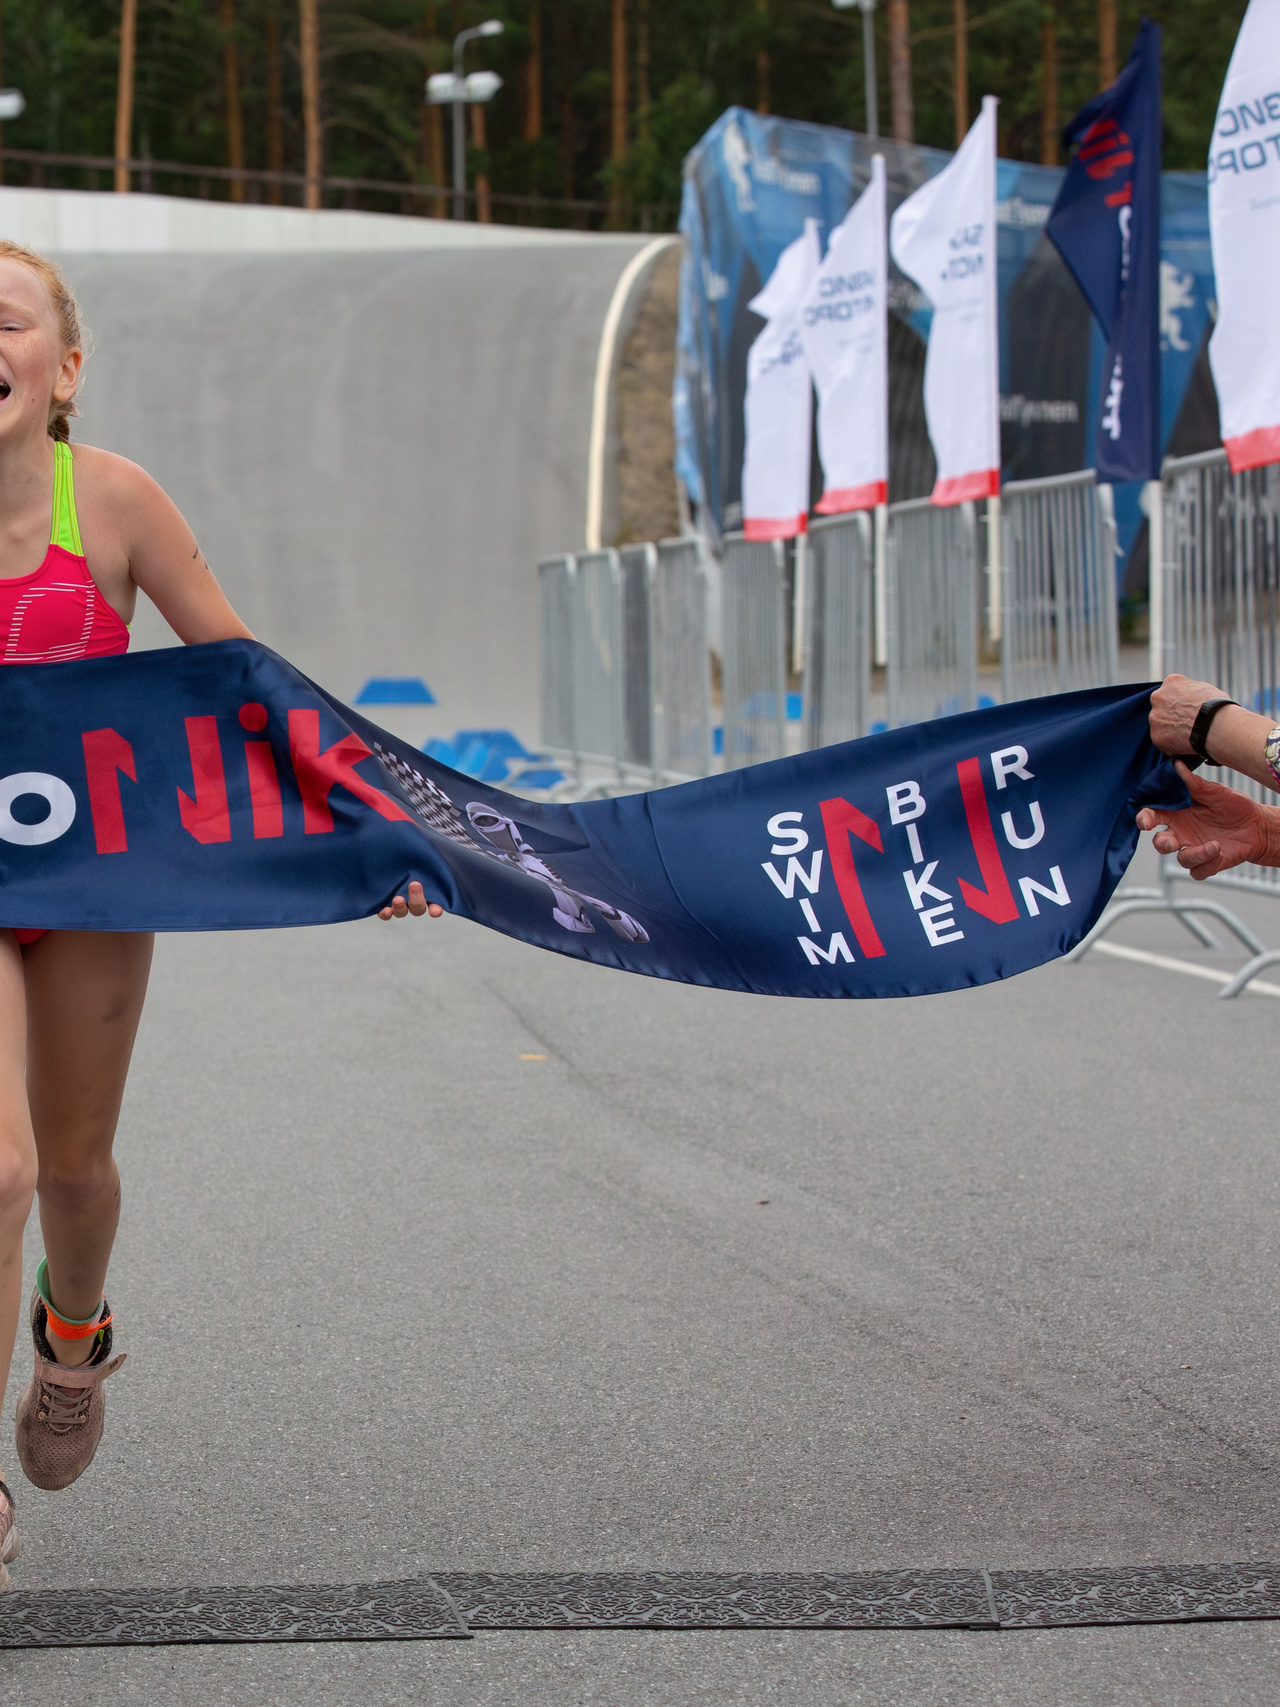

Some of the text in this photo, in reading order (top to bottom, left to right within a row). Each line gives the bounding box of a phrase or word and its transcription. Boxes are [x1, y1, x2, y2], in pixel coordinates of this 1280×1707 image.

[761, 811, 855, 965] SWIM
[885, 780, 964, 947] BIKE
[990, 745, 1071, 917] RUN
